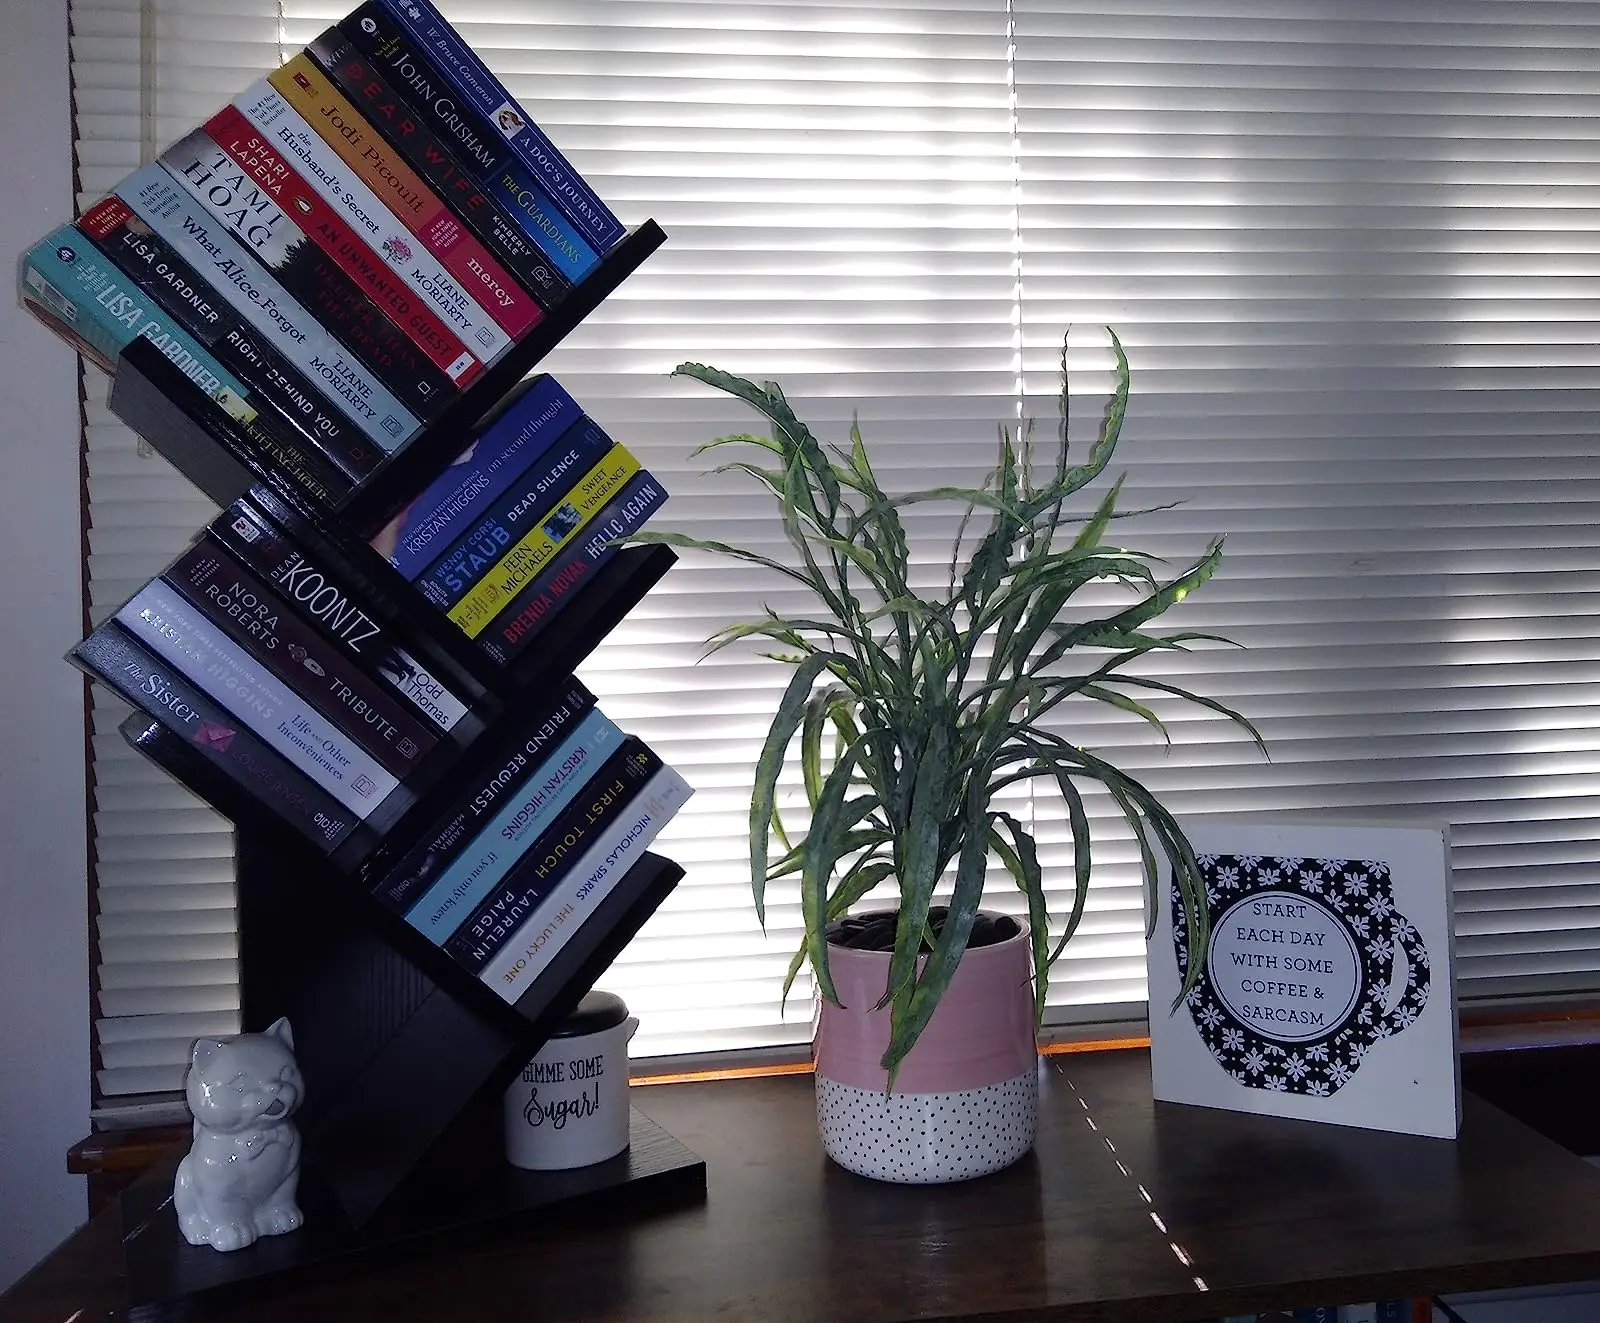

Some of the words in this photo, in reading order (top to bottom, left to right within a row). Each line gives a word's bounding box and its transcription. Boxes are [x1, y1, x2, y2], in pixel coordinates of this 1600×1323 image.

[437, 38, 461, 67] Bruce
[459, 62, 494, 106] Cameron
[392, 53, 436, 100] JOHN
[434, 98, 496, 169] GRISHAM
[248, 138, 290, 180] SHARI
[297, 131, 312, 146] the
[321, 105, 363, 148] Jodi
[361, 144, 425, 213] Picoult
[347, 61, 416, 136] DEAR
[424, 144, 485, 211] WIFE
[145, 180, 160, 193] New
[210, 152, 284, 228] TAMI
[230, 140, 283, 195] LAPENA
[278, 127, 342, 195] Husband's
[341, 193, 380, 234] Secret
[520, 134, 532, 148] A
[531, 145, 561, 184] DOG'S
[557, 178, 608, 233] JOURNEY
[141, 194, 157, 208] York
[181, 157, 273, 248] HOAG
[434, 219, 445, 228] NEW
[502, 175, 519, 194] THE
[517, 189, 581, 264] GUARDIANS
[430, 230, 442, 241] YORK
[492, 215, 532, 257] KIMBERLY
[493, 229, 518, 256] BELLE
[123, 232, 156, 264] LISA
[156, 263, 219, 323] GARDNER
[182, 215, 223, 258] What
[215, 259, 259, 298] Alice
[260, 297, 308, 345] Forgot
[316, 223, 341, 243] AN
[340, 245, 410, 314] UNWANTED
[410, 315, 451, 355] GUEST
[411, 268, 473, 329] MORIARTY
[433, 272, 470, 310] LIANE
[466, 257, 515, 308] mercy
[95, 284, 143, 329] LISA
[137, 320, 221, 398] GARDNER
[309, 356, 377, 420] MORIARTY
[333, 360, 374, 398] LIANE
[314, 412, 341, 437] YOU
[487, 460, 503, 475] on
[499, 429, 532, 464] second
[528, 398, 565, 435] thought
[291, 466, 328, 501] HOUR
[411, 521, 425, 535] YORK
[434, 485, 463, 512] BESTSELLING
[460, 468, 481, 488] AUTHOR
[507, 492, 538, 524] DEAD
[537, 449, 580, 494] SILENCE
[581, 468, 607, 495] SWEET
[581, 465, 627, 511] VENGEANCE
[406, 508, 456, 557] KRISTAN
[450, 474, 490, 516] HIGGINS
[584, 519, 624, 560] HELLO
[622, 483, 658, 524] AGAIN
[194, 558, 206, 568] NEW
[201, 558, 216, 571] TIMES
[270, 551, 301, 579] DEAN
[435, 544, 468, 579] WENDY
[469, 518, 497, 547] CORSI
[444, 525, 511, 593] STAUB
[501, 541, 554, 595] MICHAELS
[503, 543, 533, 574] FERN
[205, 584, 280, 650] ROBERTS
[228, 582, 279, 630] NORA
[279, 559, 381, 653] KOONTZ
[503, 591, 553, 645] BRENDA
[548, 557, 589, 602] NOVAK
[123, 661, 143, 681] The
[207, 660, 276, 721] HIGGINS
[415, 673, 445, 699] Odd
[141, 673, 201, 724] Sister
[328, 677, 399, 741] TRIBUTE
[406, 683, 449, 725] Thomas
[277, 721, 345, 781] Inconveniences
[291, 714, 313, 735] Life
[322, 739, 351, 767] Other
[525, 706, 572, 753] FRIEND
[469, 752, 527, 817] REQUEST
[543, 746, 587, 797] KRISTAN
[501, 791, 551, 841] HIGGINS
[586, 779, 624, 824] FIRST
[428, 813, 466, 854] MARSHALL
[438, 824, 466, 852] LAURA
[485, 851, 498, 864] if
[535, 824, 585, 879] TOUCH
[605, 815, 652, 866] NICHOLAS
[450, 874, 475, 902] only
[469, 858, 489, 879] you
[576, 861, 609, 900] SPARKS
[428, 896, 457, 928] knew
[471, 890, 515, 937] PAIGE
[473, 888, 539, 961] LAURELIN
[556, 903, 574, 923] THE
[1253, 903, 1307, 919] START
[525, 918, 558, 960] LUCKY
[1237, 927, 1284, 943] EACH
[1290, 931, 1326, 946] DAY
[503, 958, 528, 984] ONE
[1230, 952, 1278, 969] WITH
[1284, 957, 1333, 974] SOME
[1241, 979, 1308, 998] COFFEE
[1313, 987, 1325, 1000] &
[1242, 1004, 1325, 1026] SARCASM
[522, 1062, 564, 1083] GIMME
[569, 1055, 603, 1081] SOME
[523, 1081, 599, 1130] Sugar!
